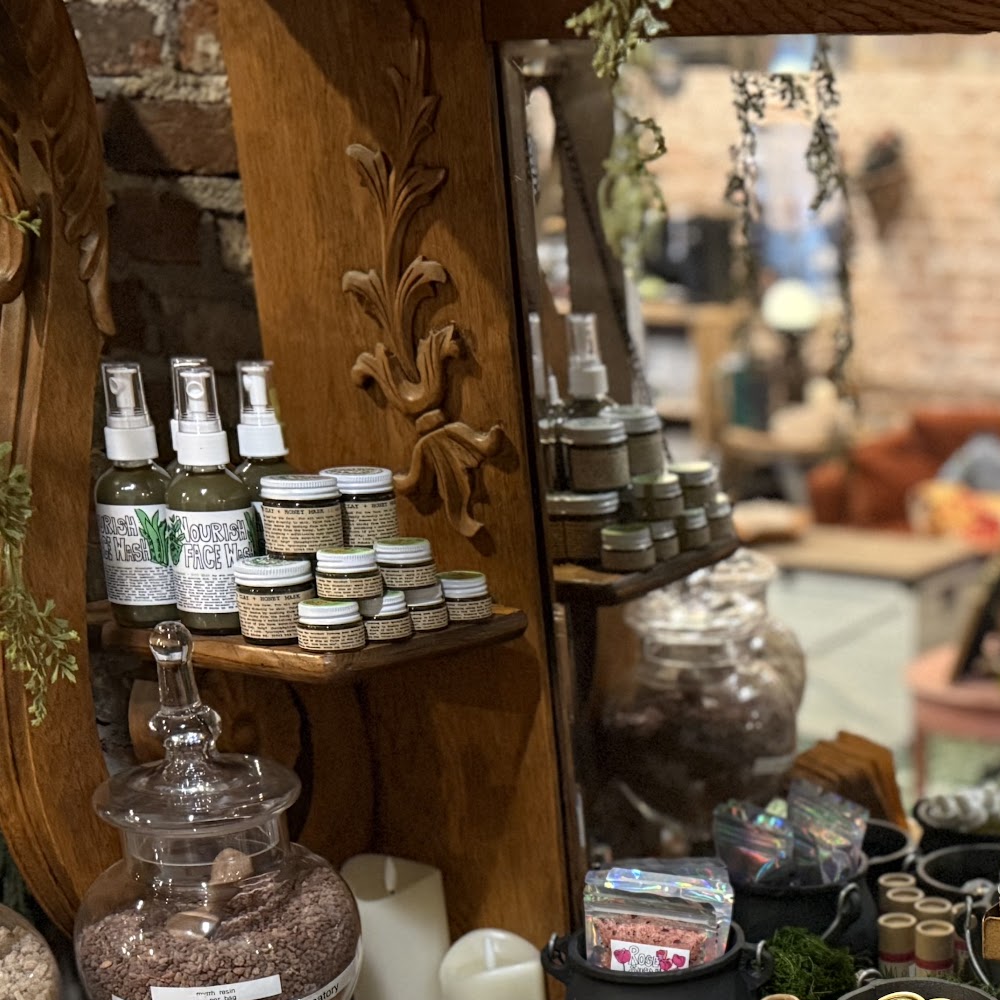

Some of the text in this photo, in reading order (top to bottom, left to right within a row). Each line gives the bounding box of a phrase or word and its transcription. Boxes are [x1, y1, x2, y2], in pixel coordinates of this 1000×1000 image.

[101, 515, 138, 537] RISH
[176, 515, 248, 543] NOURISH
[113, 538, 150, 561] WASH
[182, 544, 221, 570] FACE
[628, 945, 660, 965] ROSE
